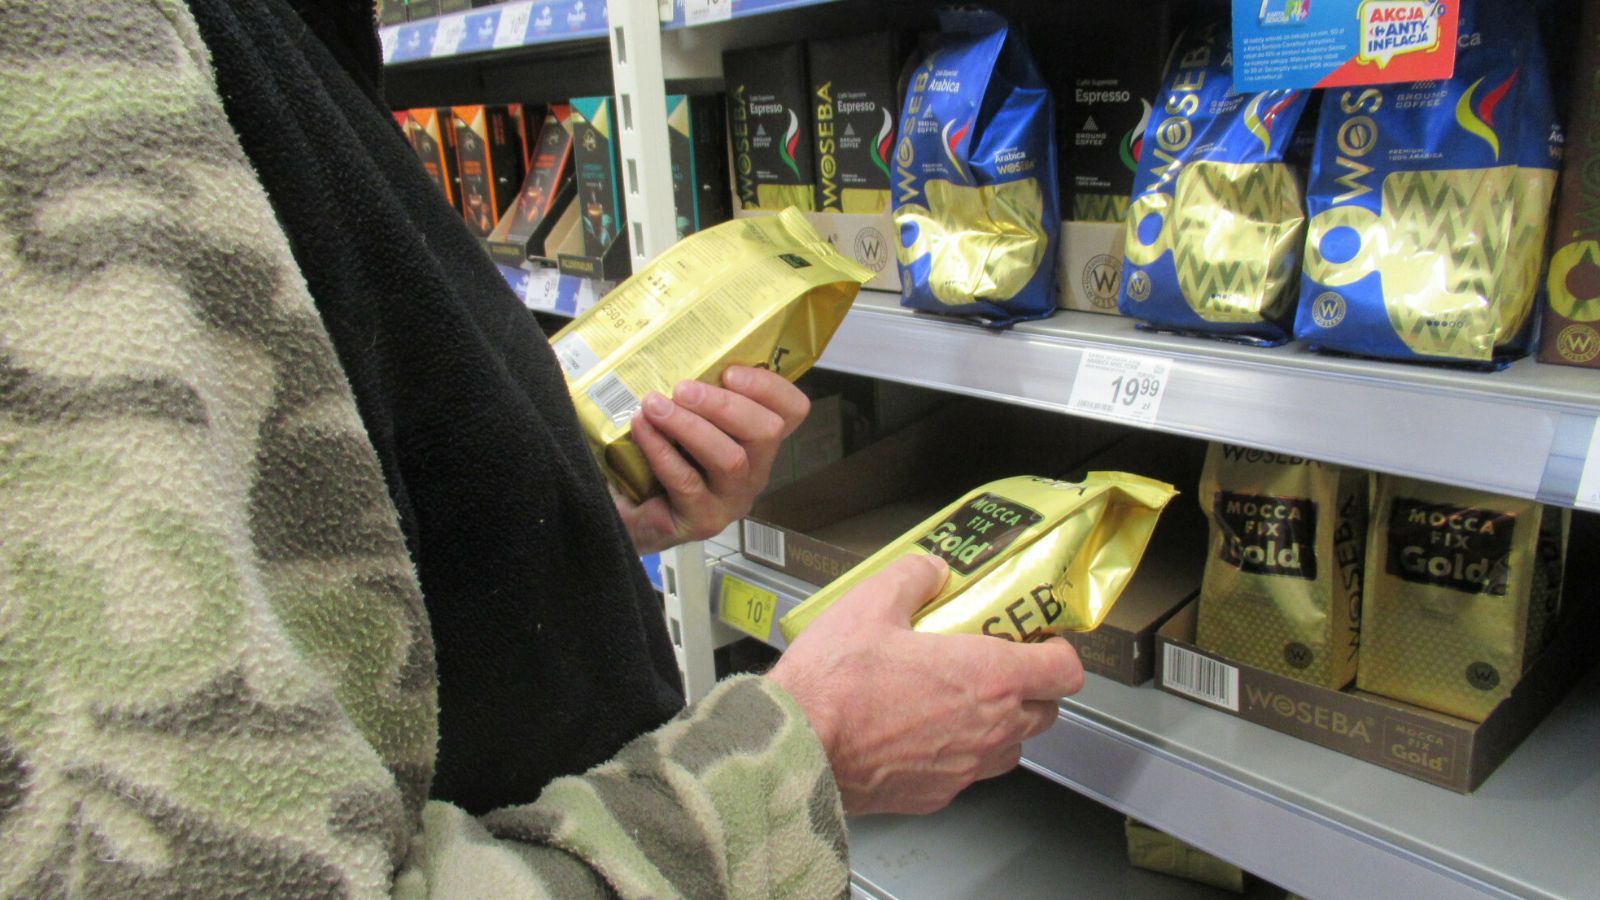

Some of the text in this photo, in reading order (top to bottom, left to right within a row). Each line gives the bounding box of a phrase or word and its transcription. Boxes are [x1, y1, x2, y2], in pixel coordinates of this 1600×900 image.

[1370, 7, 1424, 23] AKCJA
[1386, 20, 1430, 37] ANTY-
[1368, 33, 1428, 52] INFLACJA
[928, 79, 960, 93] Arabica
[1075, 89, 1130, 106] Espresso
[1395, 99, 1441, 108] COFFEE
[1397, 91, 1448, 101] GROUND
[750, 103, 782, 116] Espresso
[837, 101, 875, 115] Espresso
[816, 82, 838, 207] WOSEBA
[1331, 88, 1383, 205] WOS
[995, 151, 1026, 163] Arabica
[1111, 376, 1139, 406] 19
[1140, 378, 1160, 397] 99
[971, 498, 1023, 526] MOCCA
[1227, 500, 1301, 520] MOCCA
[966, 516, 995, 534] FIX
[1246, 520, 1279, 537] FIX
[1408, 509, 1495, 535] MOCCA
[927, 522, 990, 565] Gold
[1431, 531, 1470, 549] FIX
[1231, 536, 1301, 568] Gold
[1402, 546, 1489, 585] Gold
[982, 573, 1074, 642] SEB
[1245, 684, 1371, 743] WOSEBA
[1395, 725, 1444, 746] MOCCA
[1408, 738, 1430, 750] FIX
[1391, 744, 1443, 771] Gold
